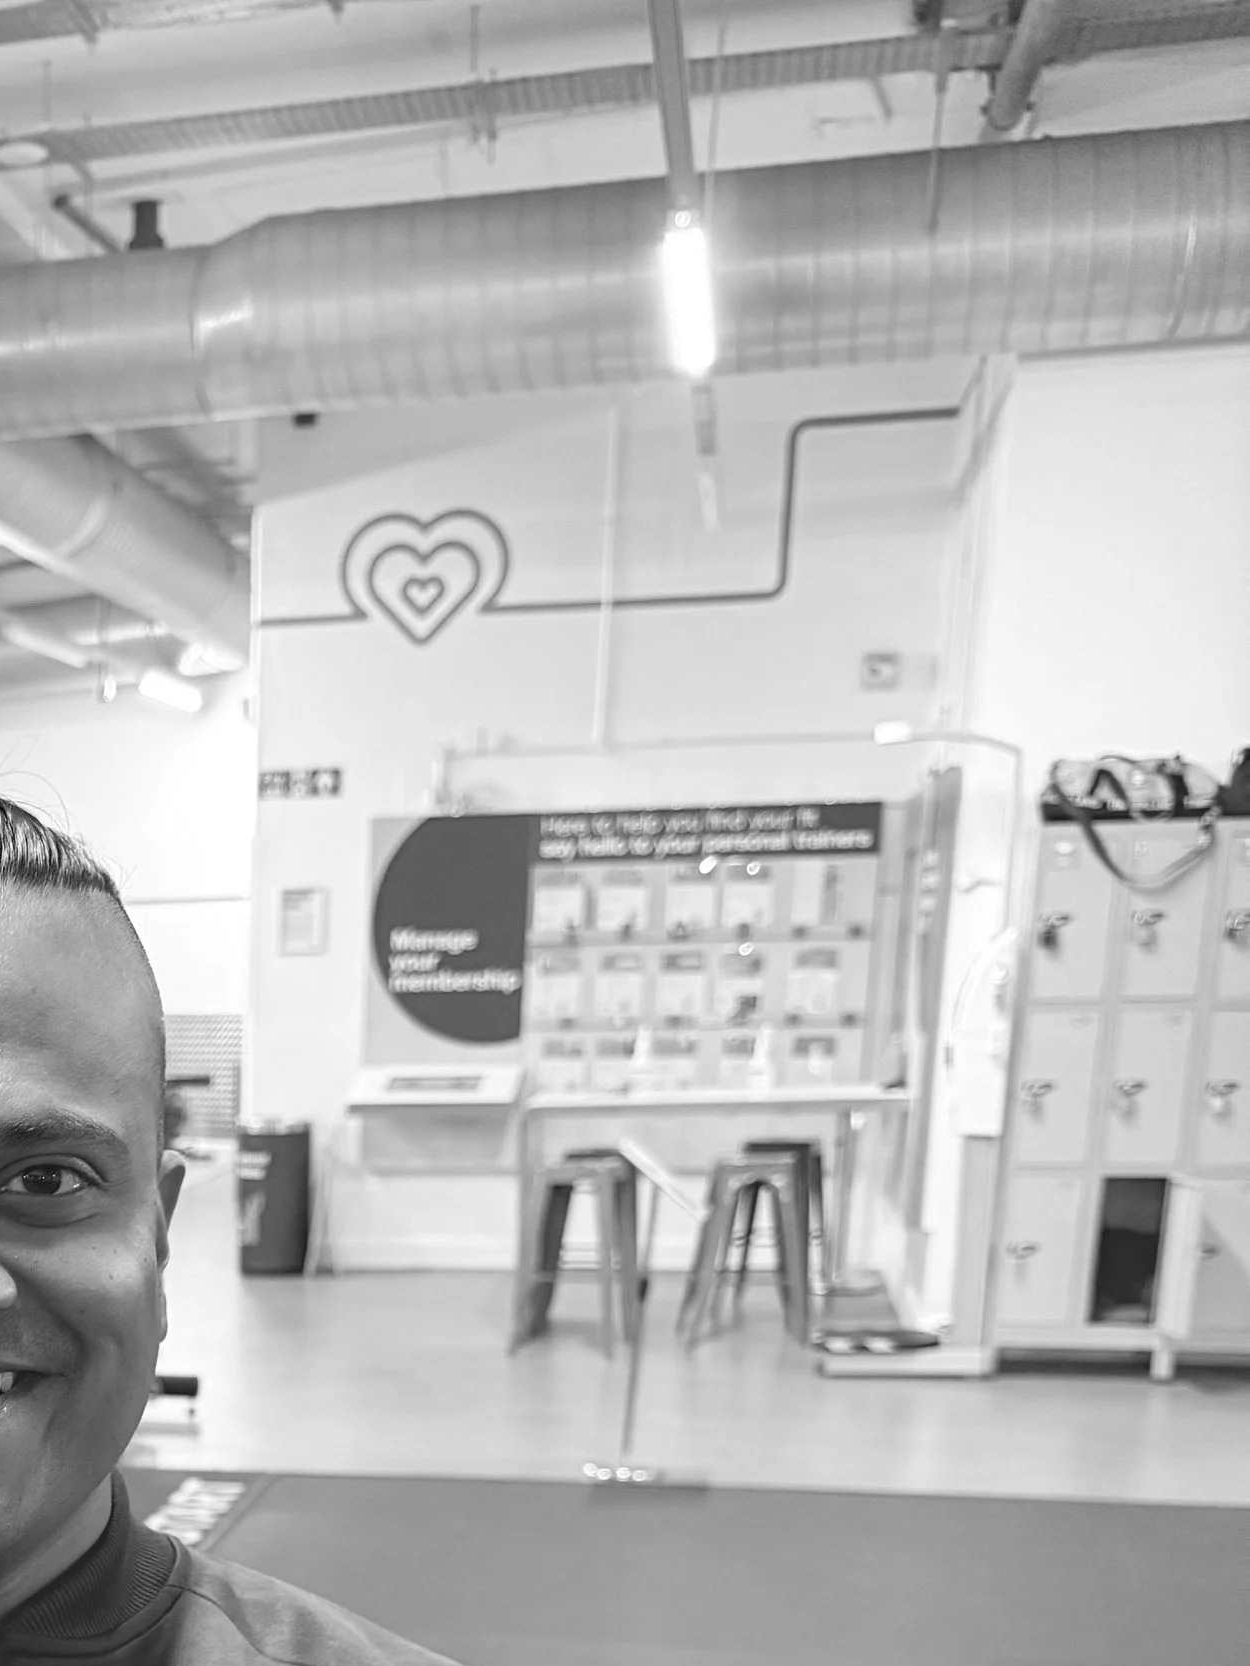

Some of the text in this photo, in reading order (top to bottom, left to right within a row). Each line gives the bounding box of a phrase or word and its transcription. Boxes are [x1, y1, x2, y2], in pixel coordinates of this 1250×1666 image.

[578, 834, 628, 857] hello
[629, 834, 653, 857] to
[654, 833, 701, 860] your
[702, 830, 791, 854] personal
[792, 827, 875, 850] trainers
[390, 927, 479, 955] Manage
[388, 951, 442, 973] your
[388, 967, 521, 995] membership
